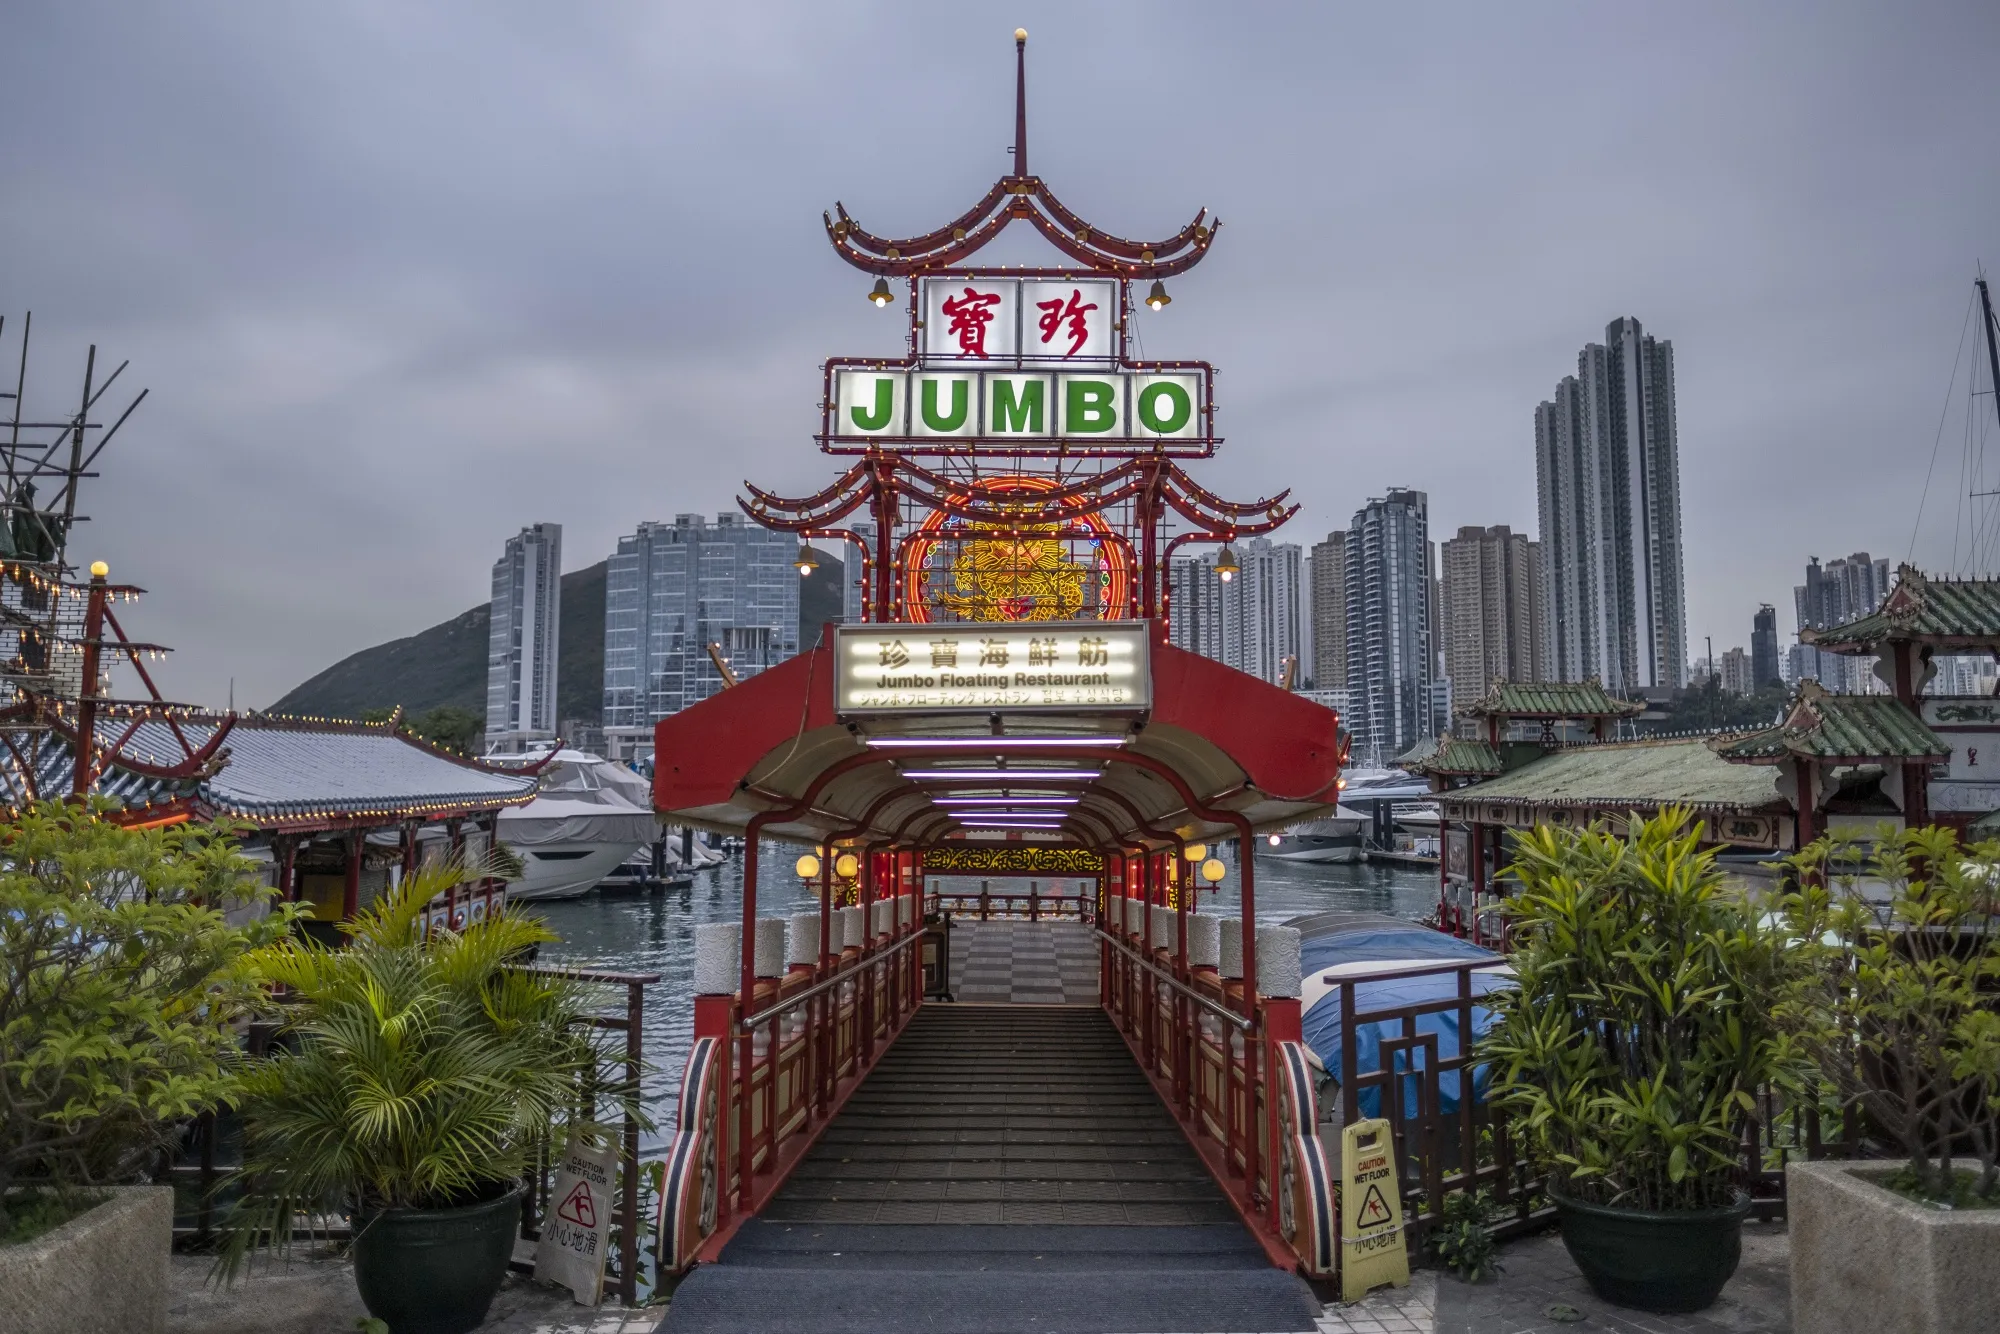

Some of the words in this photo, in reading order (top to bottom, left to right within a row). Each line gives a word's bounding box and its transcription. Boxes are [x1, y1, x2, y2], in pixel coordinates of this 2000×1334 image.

[850, 379, 1192, 434] JUMBO
[878, 636, 1109, 670] 珍寶海鮮舫
[876, 674, 935, 689] Jumbo
[940, 673, 1009, 689] Floating
[1014, 672, 1110, 686] Restaurant
[566, 1163, 582, 1176] WET
[582, 1169, 608, 1186] FLOOR
[571, 1156, 605, 1175] CAUTION
[1357, 1156, 1386, 1172] CAUTION
[1354, 1172, 1369, 1185] WET
[1369, 1167, 1390, 1181] FLOOR
[548, 1218, 598, 1256] 小心地滑
